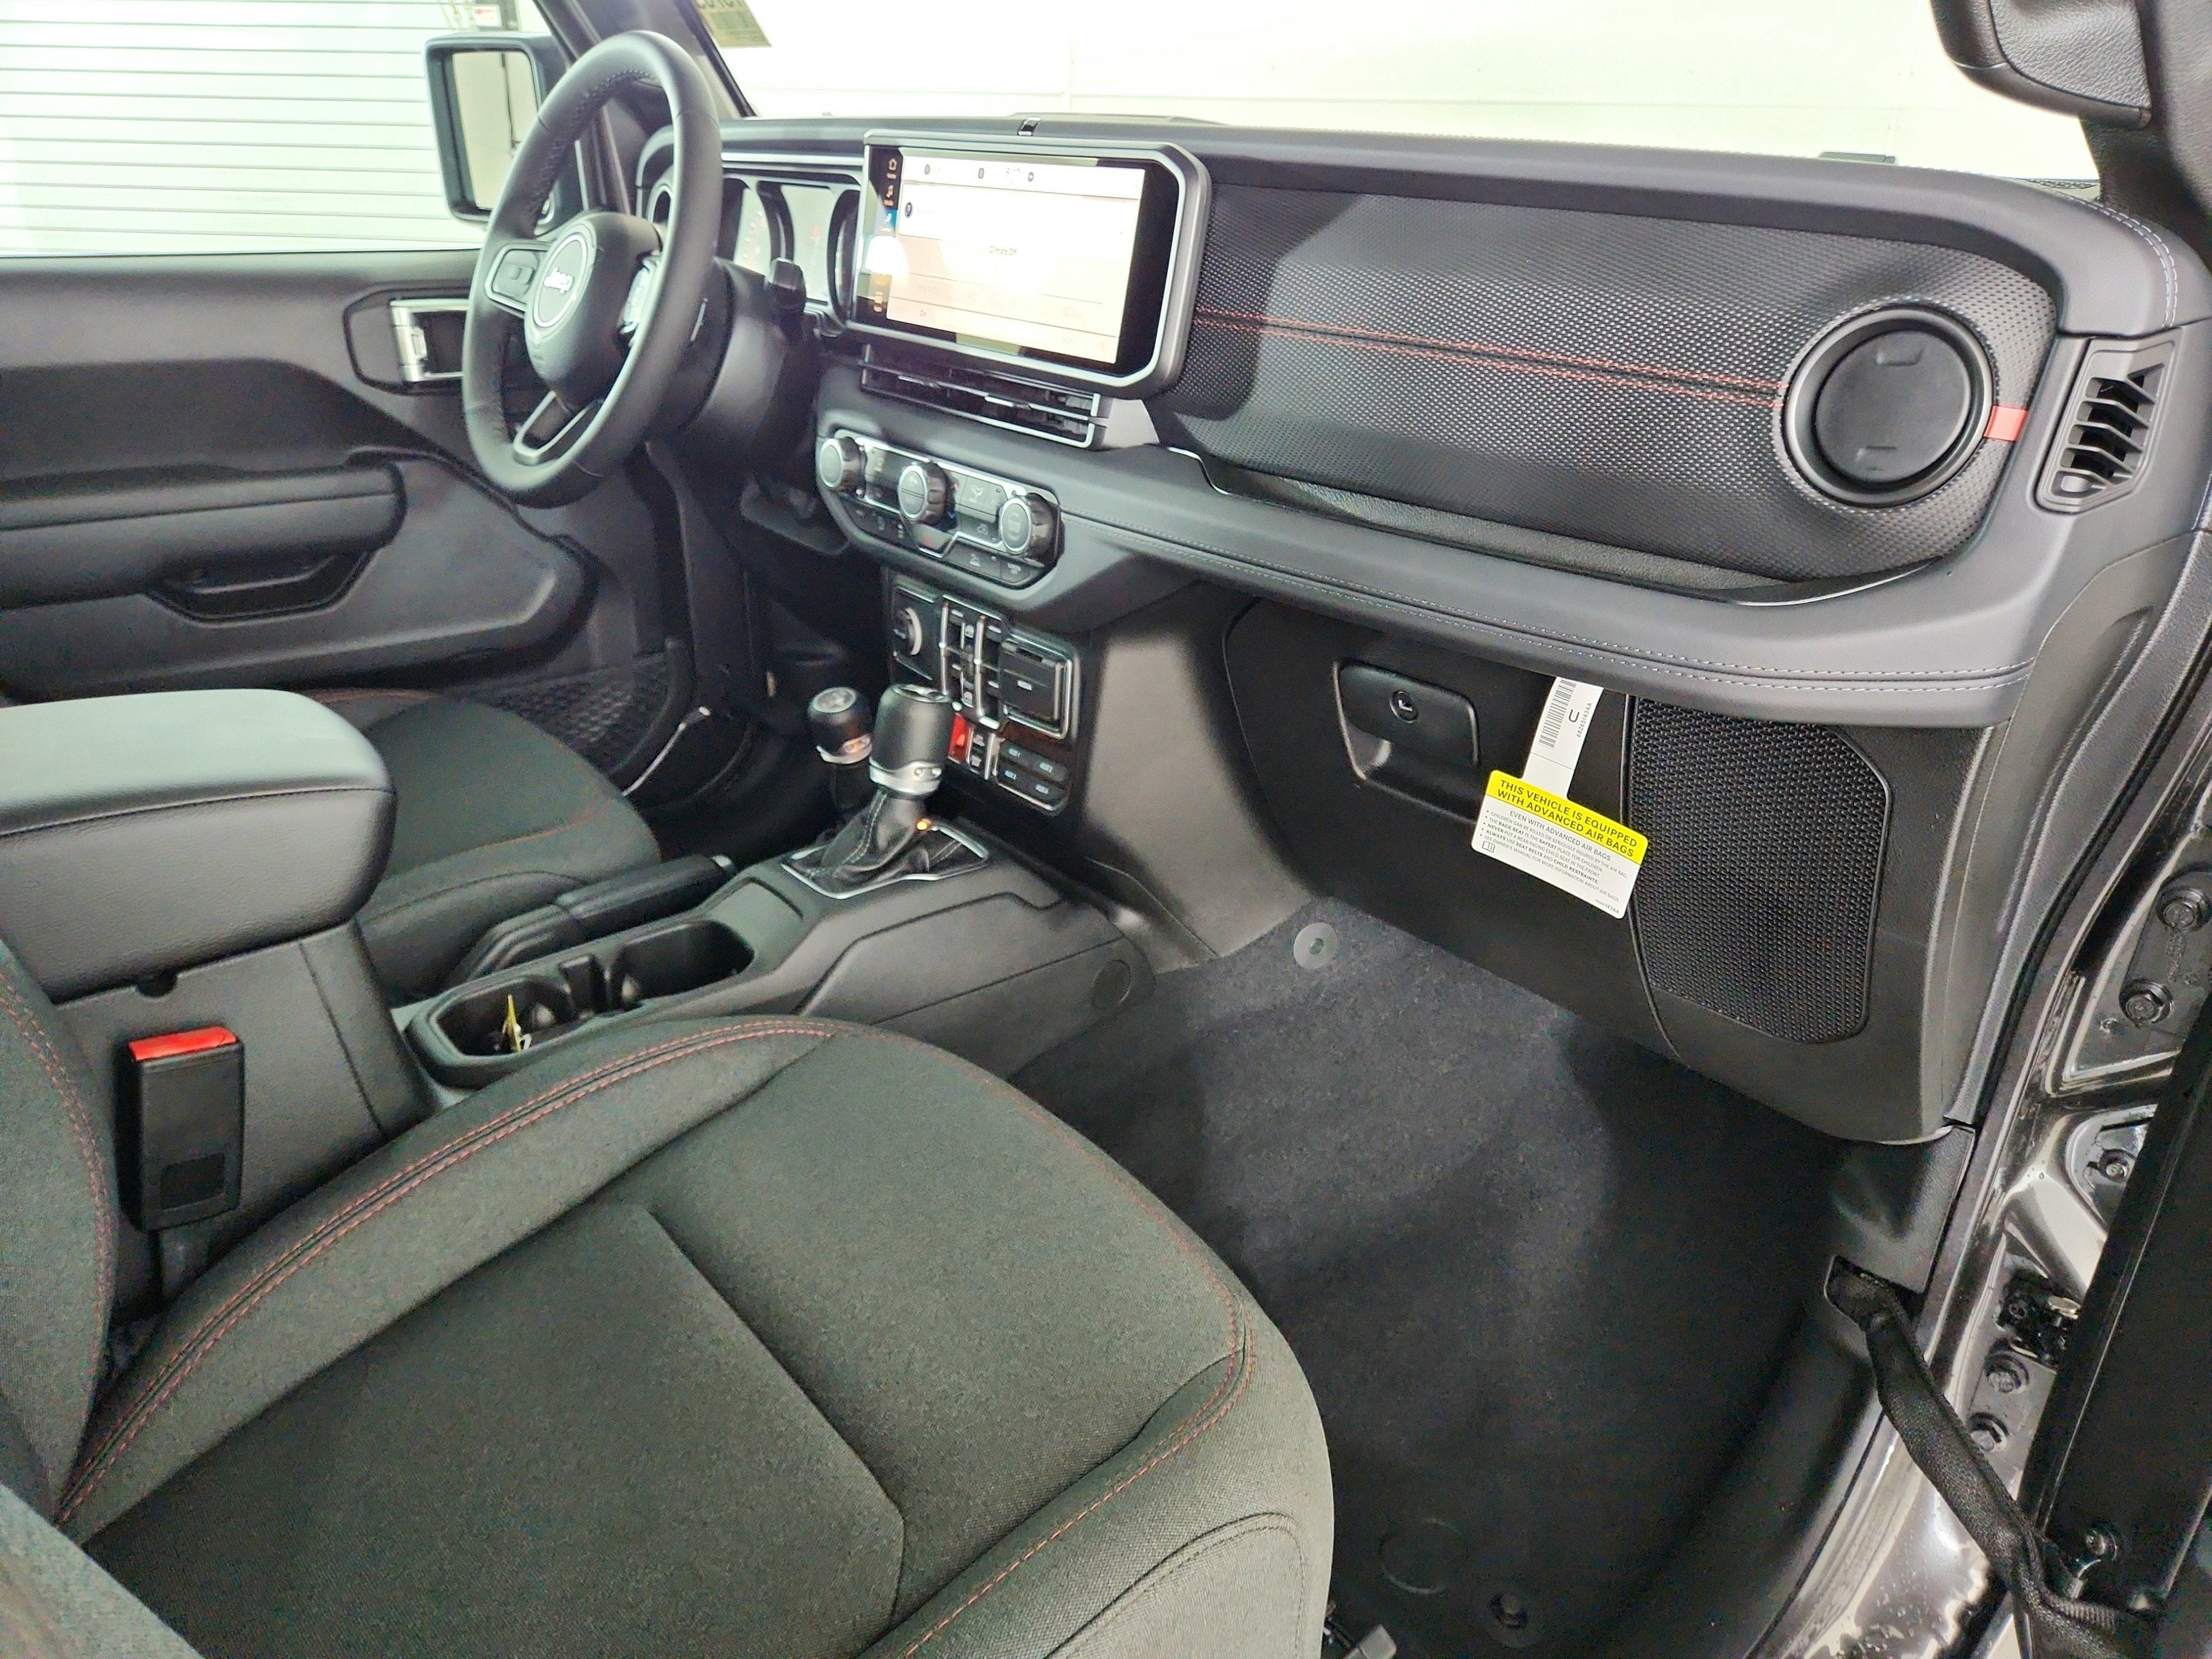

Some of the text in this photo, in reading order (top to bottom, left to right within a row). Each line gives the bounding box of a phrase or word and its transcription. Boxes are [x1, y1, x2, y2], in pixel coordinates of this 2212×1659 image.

[1568, 709, 1580, 723] U
[1576, 703, 1593, 738] 68265143AA
[1498, 789, 1634, 857] WITH ADVANCED AIR BAGS
[1500, 780, 1637, 847] THIS VEHICLE IS EQUIPPED
[1486, 830, 1506, 840] ALWAYS
[1528, 848, 1543, 857] BELTS
[1553, 859, 1568, 868] CHILD
[1488, 823, 1504, 833] NEVER
[1517, 836, 1545, 851] REAR-FACING
[1545, 849, 1559, 857] CHILD
[1491, 812, 1513, 823] CHILDREN
[1530, 827, 1544, 837] KILLED
[1552, 838, 1576, 851] SERIOUSLY
[1576, 850, 1594, 861] INJURED
[1498, 821, 1511, 830] BACK
[1539, 839, 1556, 850] SAFEST
[1557, 847, 1571, 856] PLACE
[1510, 810, 1611, 861] EVEN WITH ADVANCED AIR BAGS
[1493, 839, 1513, 850] OWNER'S
[1513, 847, 1532, 859] MANUAL
[1542, 860, 1554, 868] MORE
[1555, 867, 1584, 883] INFORMATION
[1584, 881, 1599, 891] ABOUT
